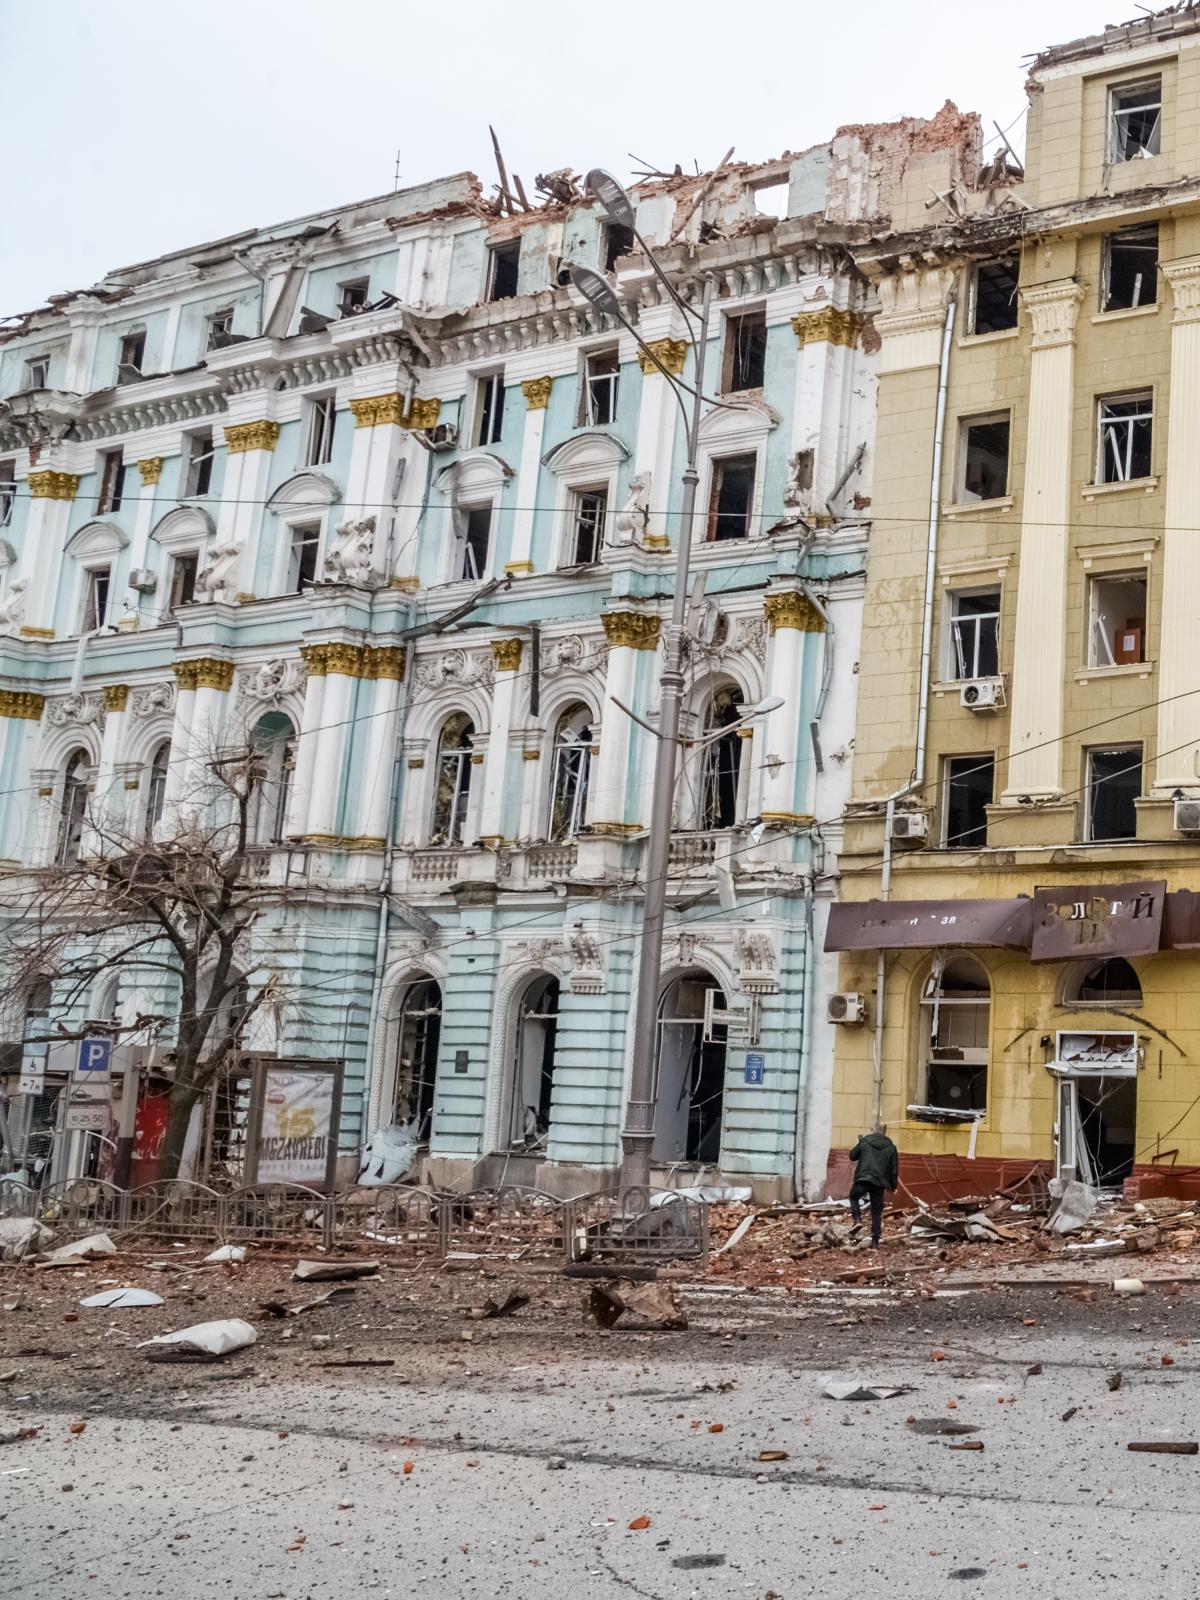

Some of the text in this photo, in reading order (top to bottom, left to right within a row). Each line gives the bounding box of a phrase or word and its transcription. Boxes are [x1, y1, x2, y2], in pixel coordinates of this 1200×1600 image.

[87, 1044, 104, 1067] P
[751, 1070, 757, 1080] 3
[276, 1104, 316, 1138] 15
